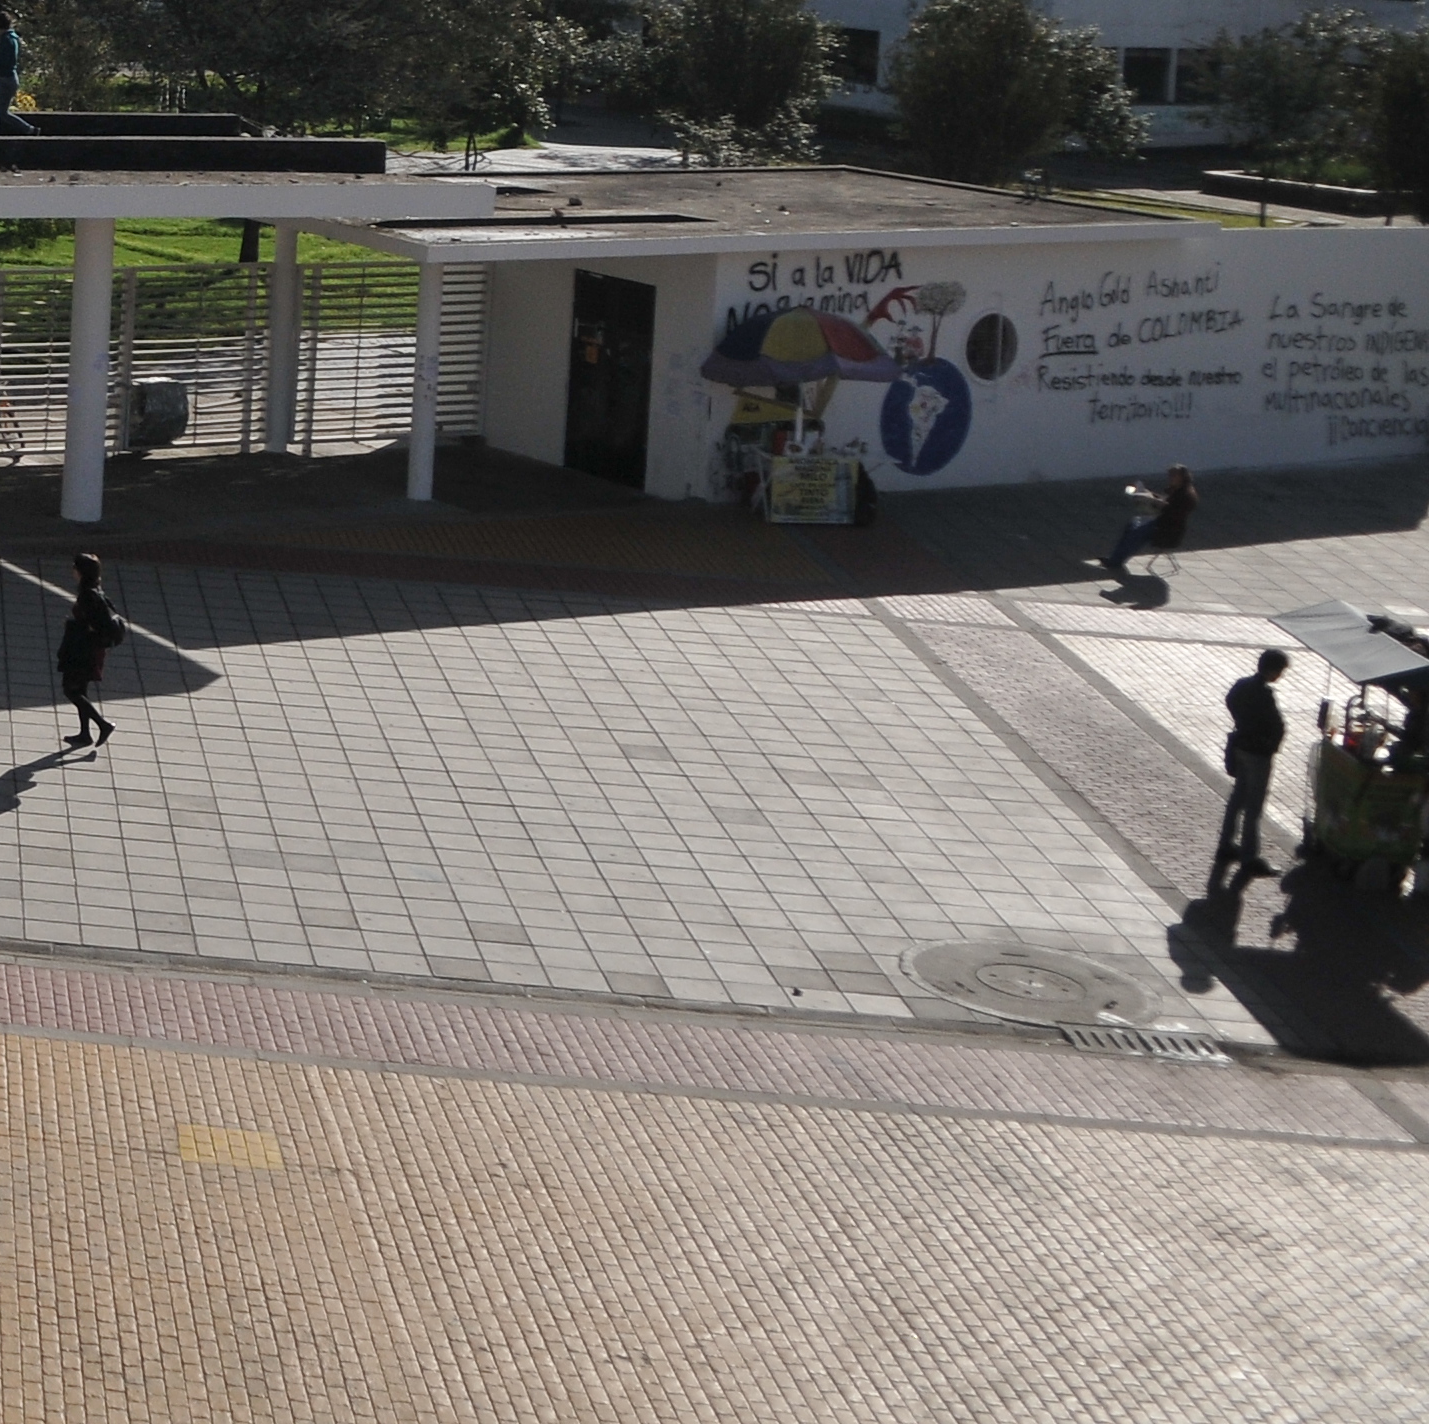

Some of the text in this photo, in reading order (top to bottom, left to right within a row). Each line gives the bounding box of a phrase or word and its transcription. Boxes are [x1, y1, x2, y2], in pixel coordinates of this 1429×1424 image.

[792, 267, 806, 287] a
[815, 256, 834, 288] la
[845, 250, 902, 285] VIDA
[820, 287, 871, 315] mina
[1269, 295, 1299, 320] La
[1388, 297, 1408, 317] de
[1041, 309, 1244, 353] Fuera de COLOMBIA
[1267, 326, 1357, 352] nuestros
[1037, 361, 1135, 392] Resistiendo
[1141, 368, 1182, 387] desde
[1261, 357, 1277, 382] el
[1371, 361, 1389, 383] de
